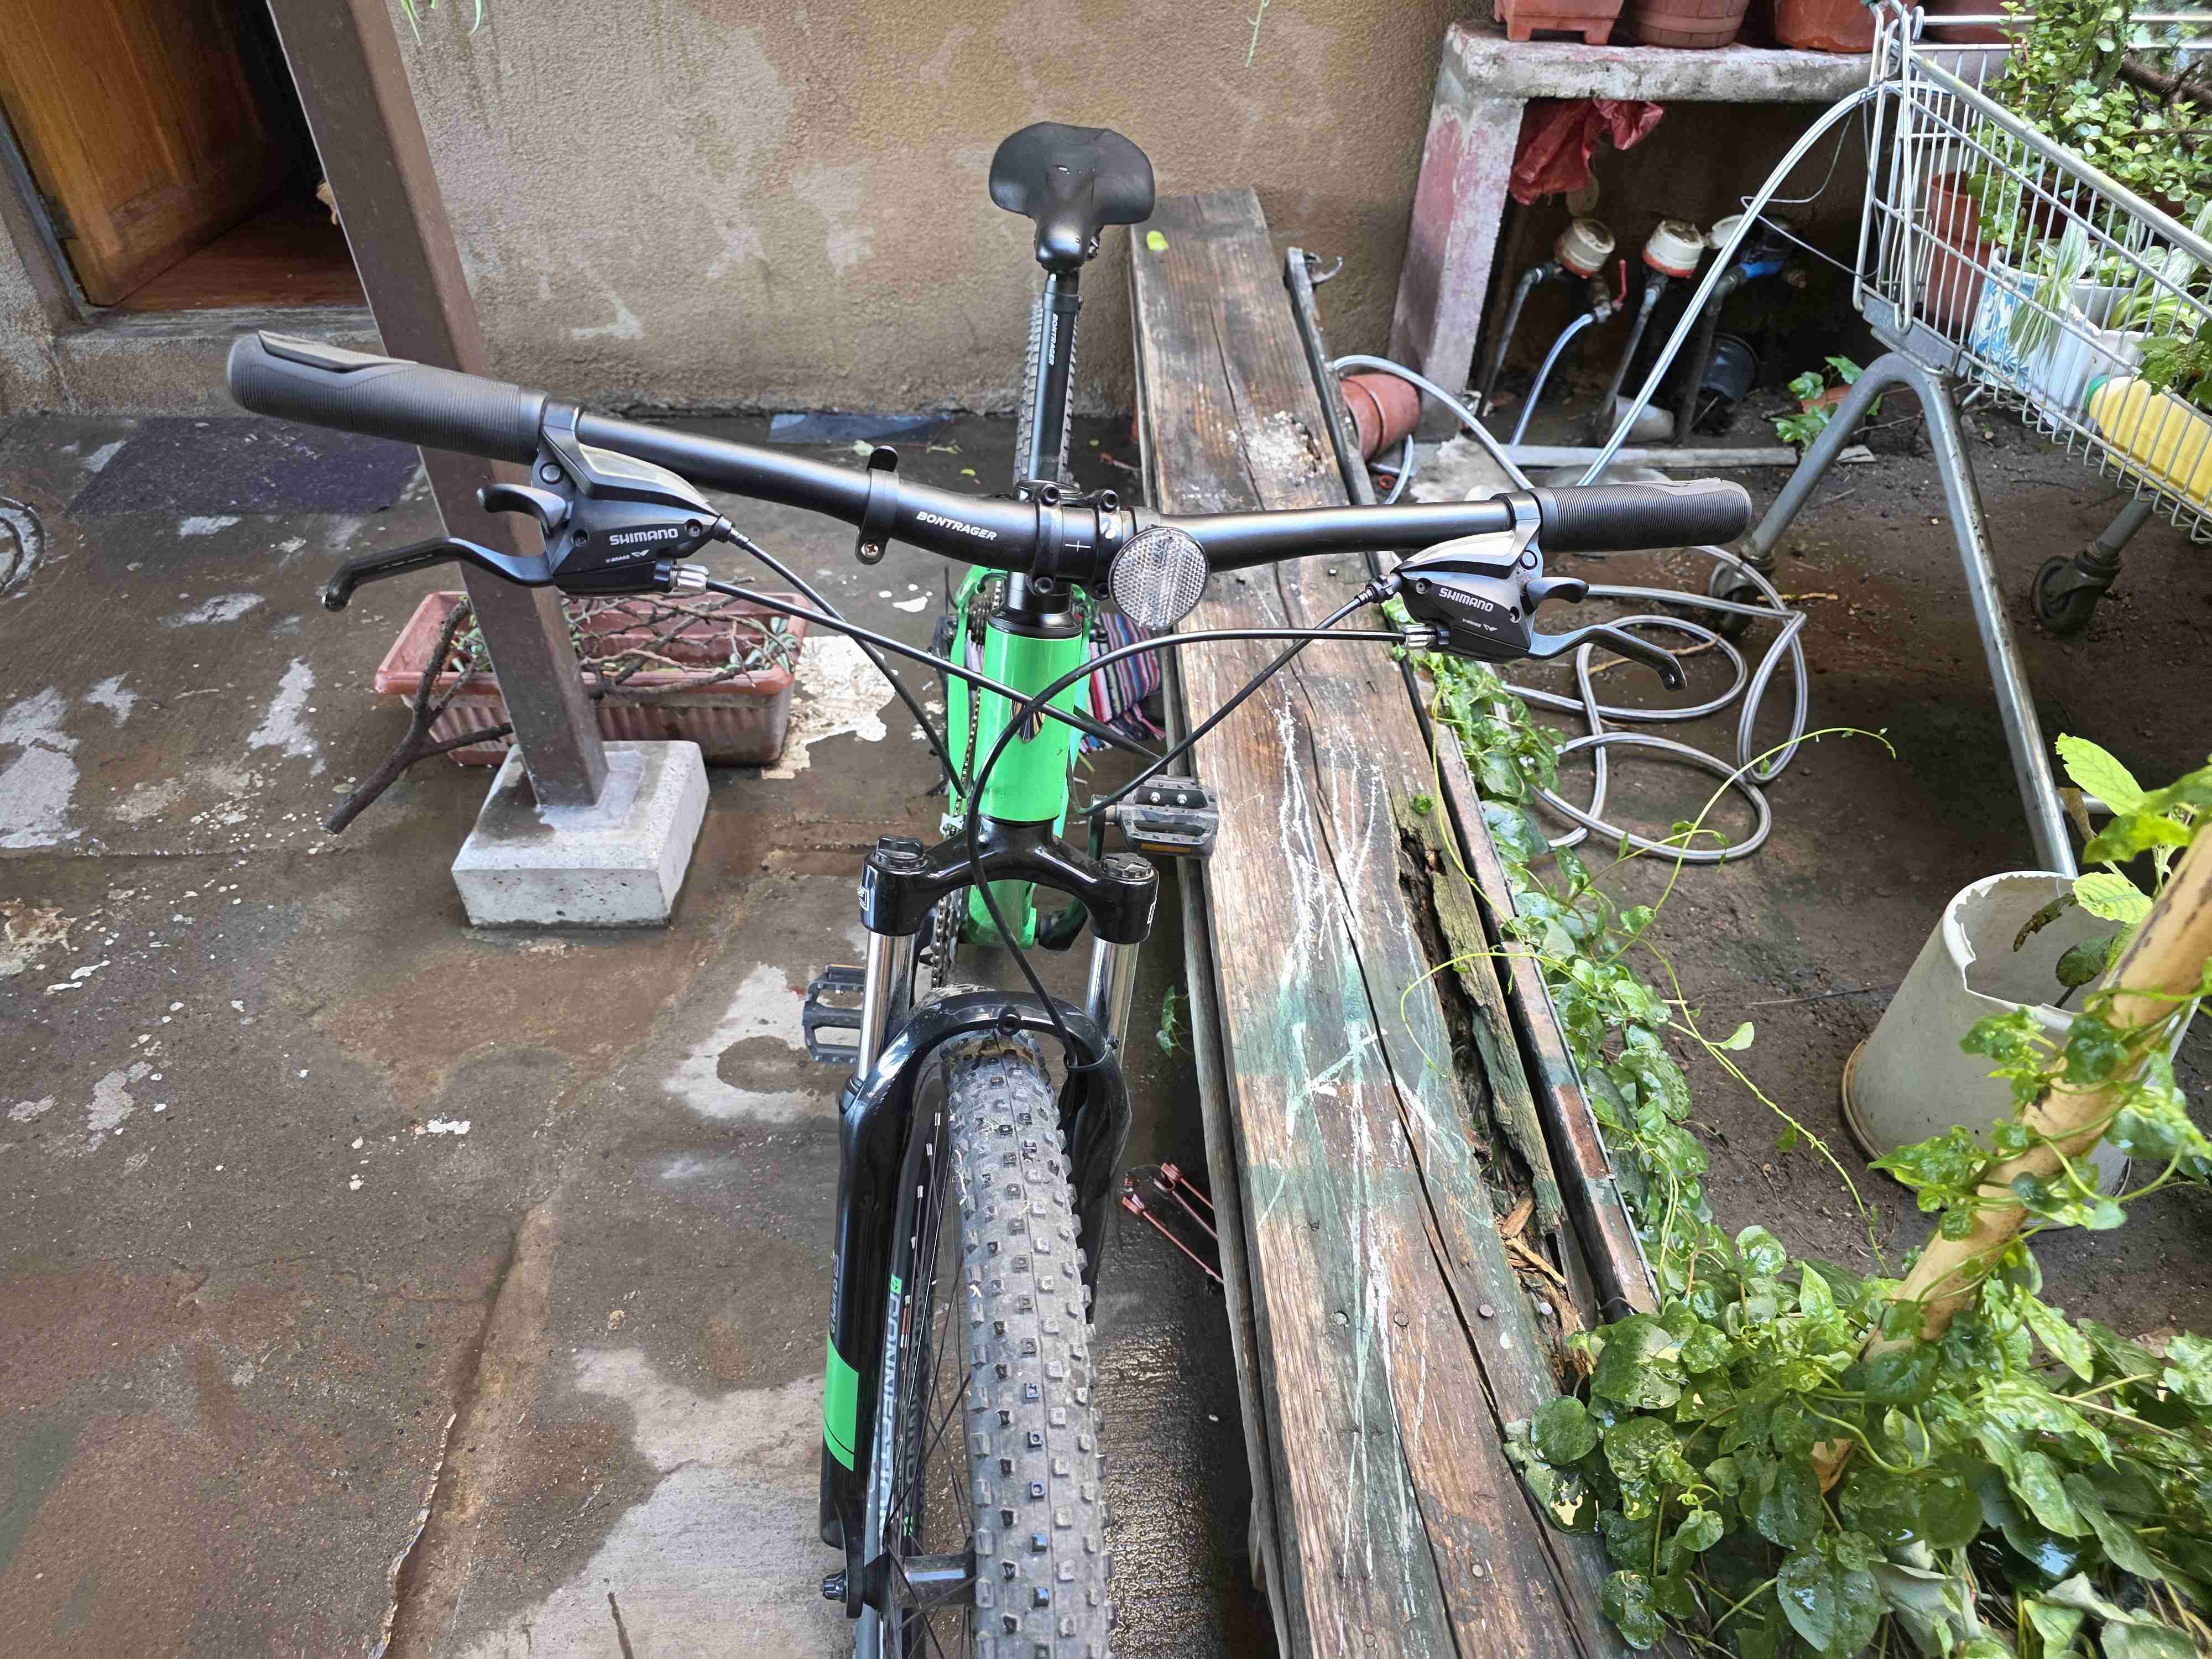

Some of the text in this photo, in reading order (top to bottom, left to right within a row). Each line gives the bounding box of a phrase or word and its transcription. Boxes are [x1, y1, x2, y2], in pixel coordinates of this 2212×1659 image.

[1048, 313, 1058, 366] BONTRAGER
[609, 528, 679, 546] SHIMANO
[916, 511, 997, 540] BONTRAGER
[1438, 587, 1494, 612] SHIMANO
